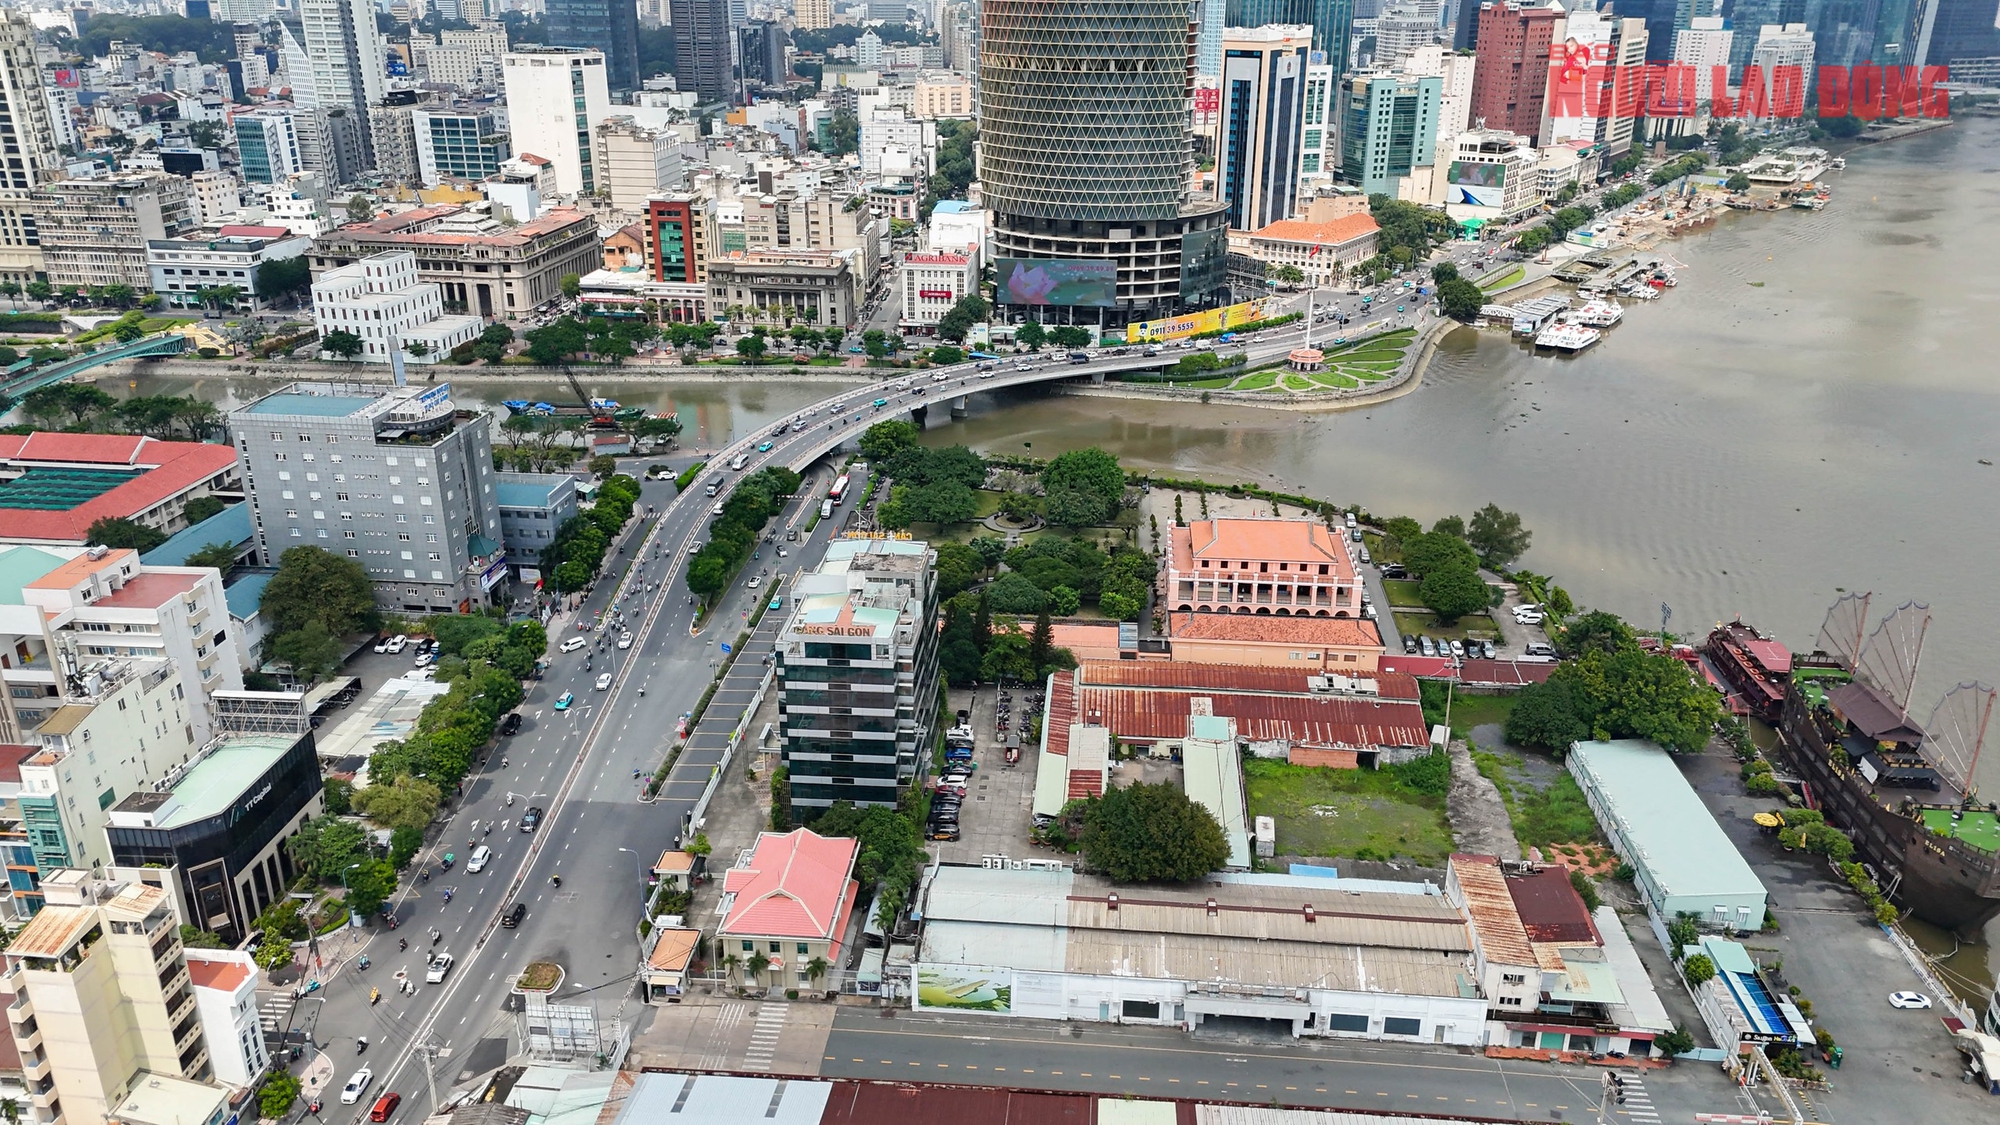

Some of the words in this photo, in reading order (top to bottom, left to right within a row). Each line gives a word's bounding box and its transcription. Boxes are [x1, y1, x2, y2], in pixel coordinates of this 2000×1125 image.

[914, 254, 966, 263] AGRIBANK
[1150, 326, 1165, 336] 0911
[1167, 325, 1176, 333] 39
[1177, 321, 1194, 331] 5555
[1828, 758, 1845, 781] ELISA
[1924, 840, 1946, 857] ELISA
